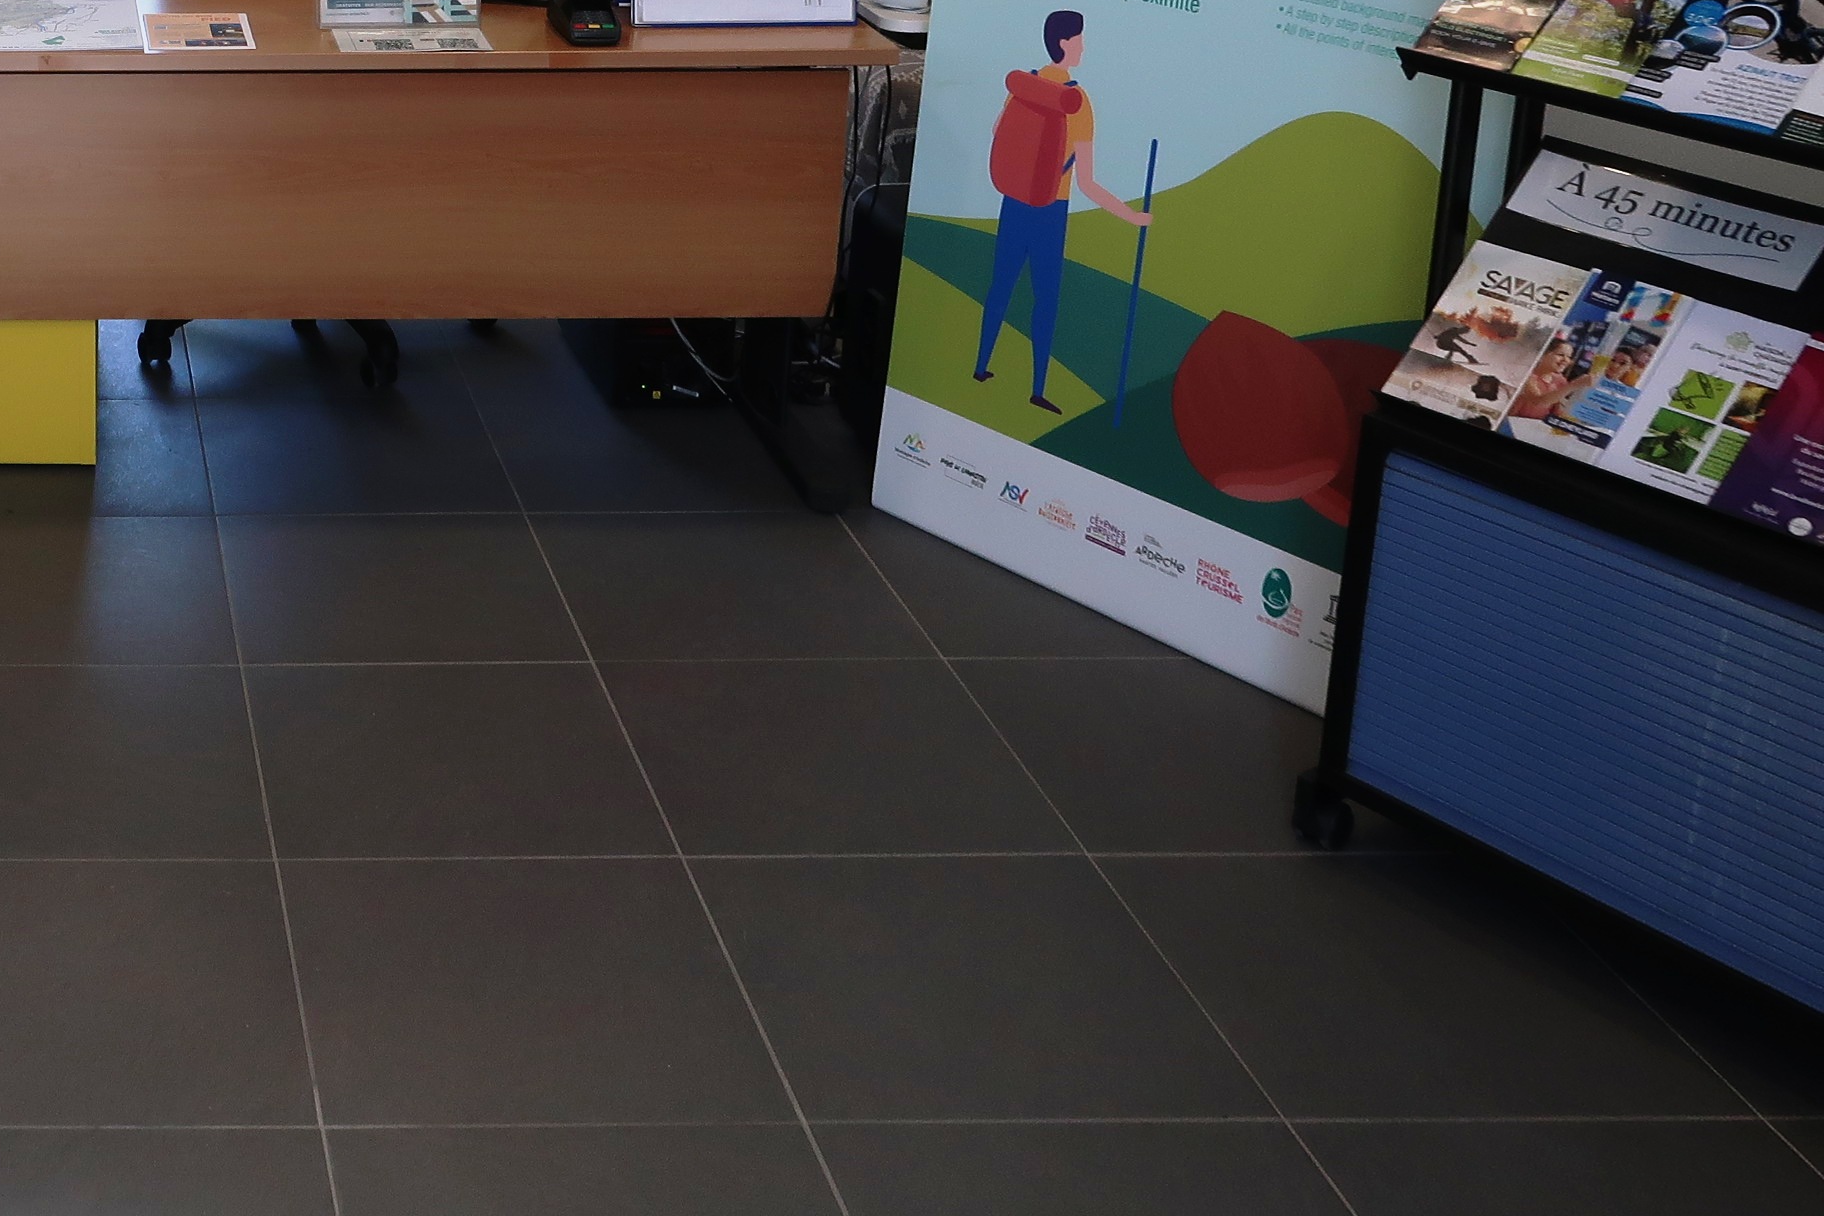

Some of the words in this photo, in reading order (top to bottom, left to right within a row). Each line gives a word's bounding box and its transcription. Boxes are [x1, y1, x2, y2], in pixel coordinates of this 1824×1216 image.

[1557, 164, 1592, 196] À
[1594, 184, 1645, 215] 45
[1648, 197, 1796, 254] minutes
[1480, 270, 1570, 309] SAVAGE
